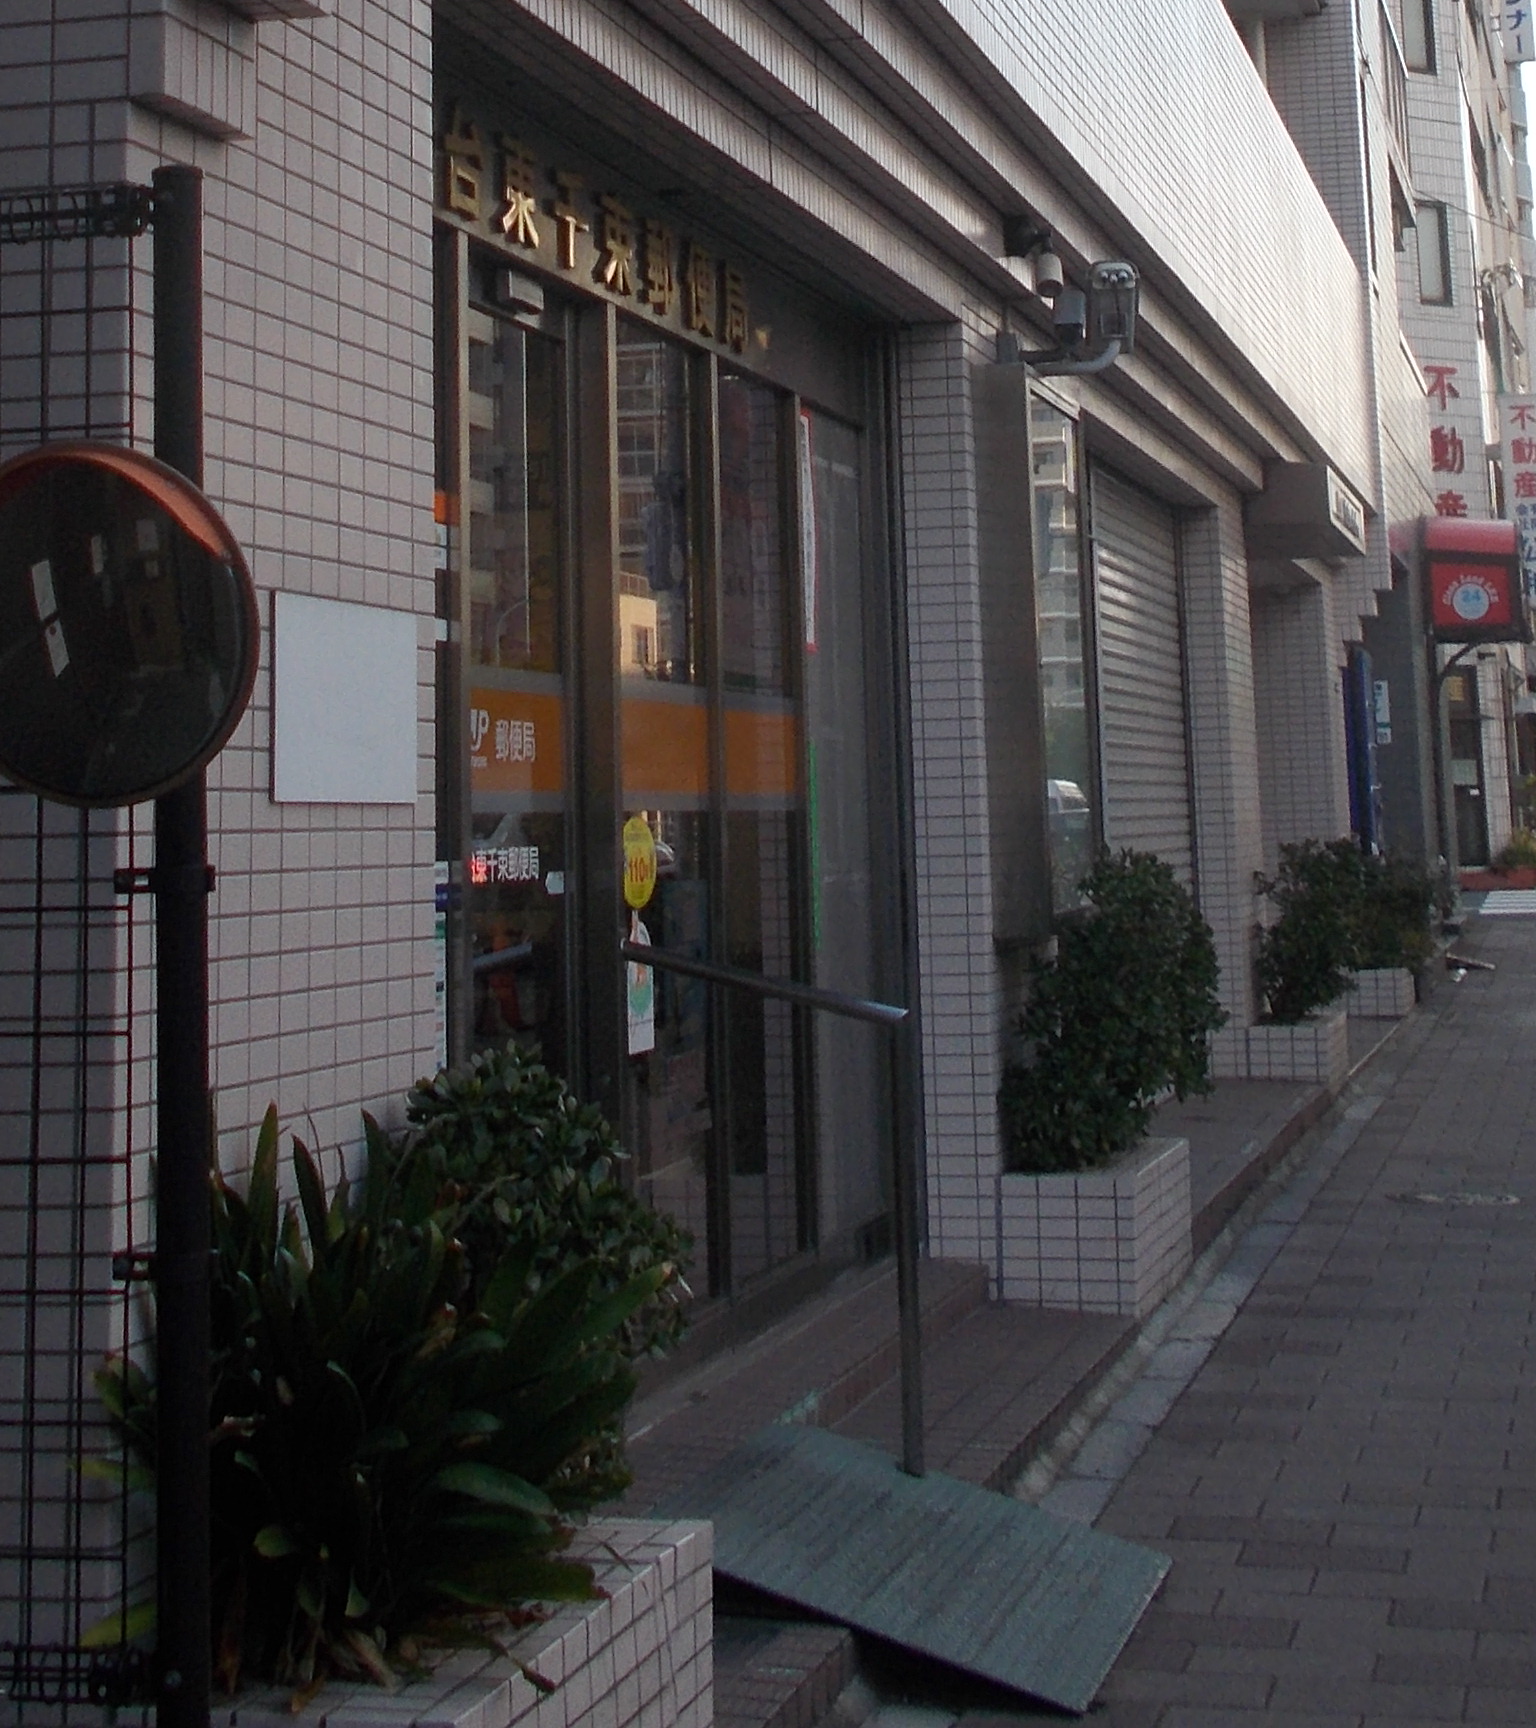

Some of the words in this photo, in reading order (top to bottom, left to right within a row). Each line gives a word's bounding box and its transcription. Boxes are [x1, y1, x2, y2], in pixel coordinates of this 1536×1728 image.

[444, 104, 750, 354] 台東千束郵便局
[496, 720, 536, 762] 郵便局
[472, 846, 540, 883] 東千束郵便局
